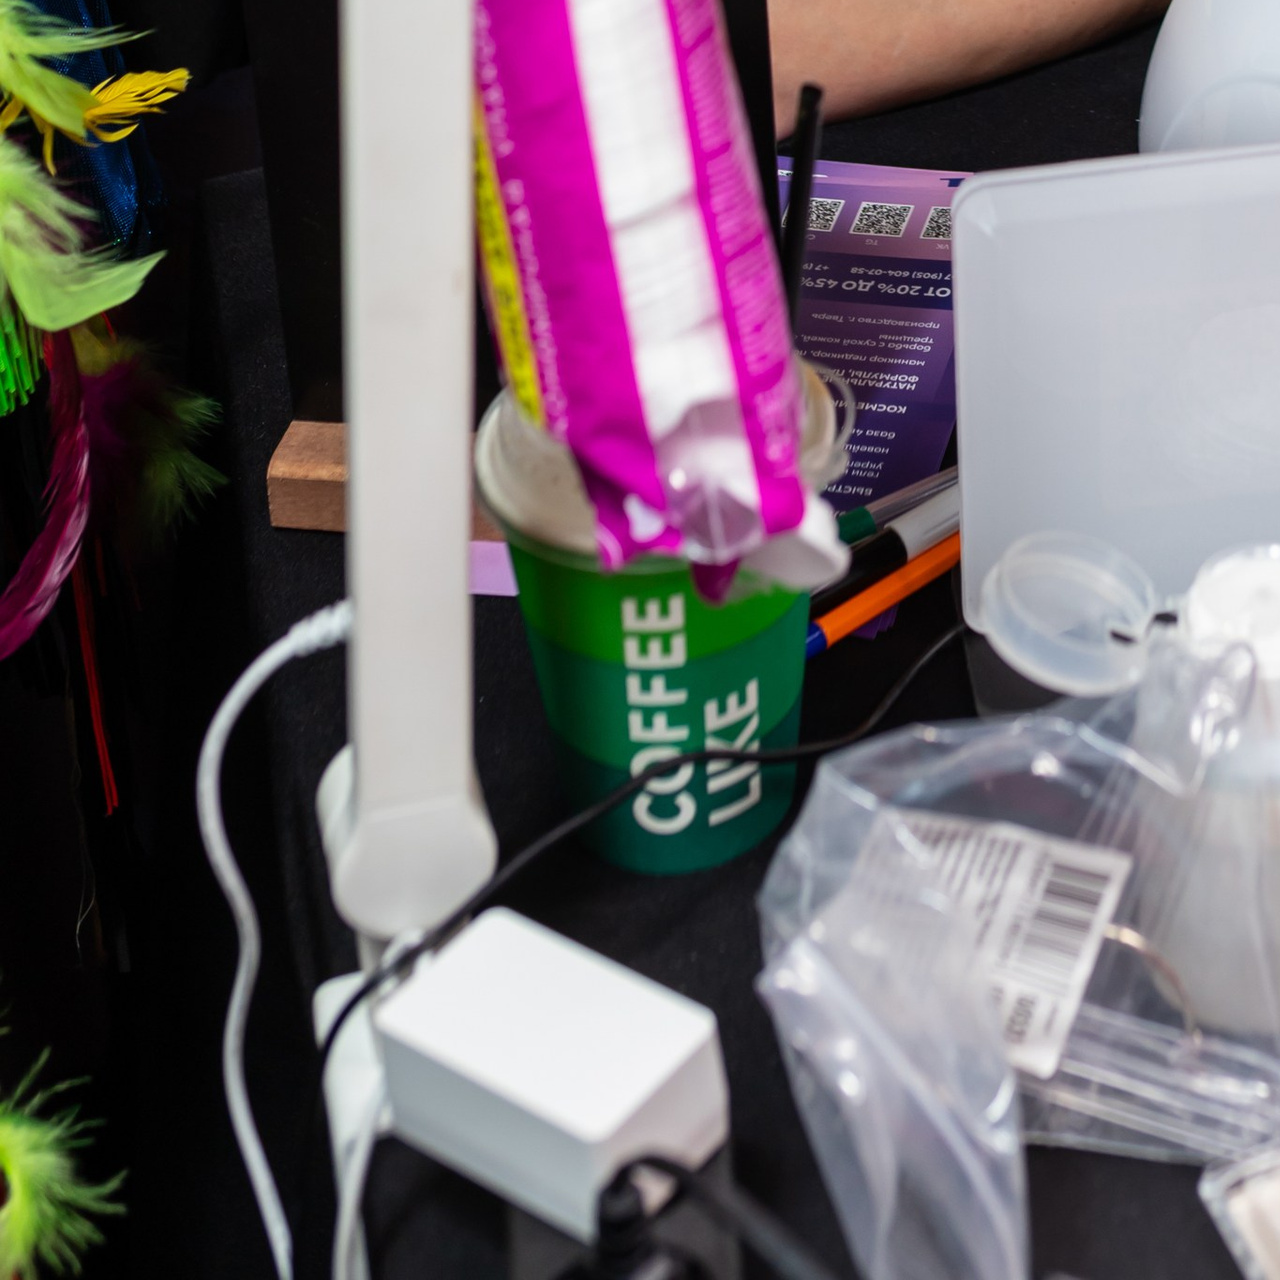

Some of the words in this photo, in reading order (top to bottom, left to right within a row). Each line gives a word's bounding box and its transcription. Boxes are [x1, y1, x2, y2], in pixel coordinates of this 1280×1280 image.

[850, 267, 910, 277] 604-07-58
[912, 271, 942, 279] (905)
[800, 276, 838, 289] 45%
[842, 280, 875, 292] ДО
[878, 283, 921, 295] 20%
[924, 287, 952, 297] ОТ
[811, 313, 844, 322] Тверь
[858, 317, 940, 329] производство
[801, 334, 840, 344] кожей,
[843, 338, 876, 347] сухой
[879, 334, 934, 343] трещины
[887, 342, 931, 352] борьба
[870, 355, 925, 366] маникюр
[849, 369, 919, 382] ФОРМУЛЫ,
[833, 400, 907, 413] КОСМЕИК
[865, 430, 895, 439] база
[852, 469, 879, 478] гели
[621, 592, 697, 835] COFFEE
[703, 678, 762, 828] LIKE
